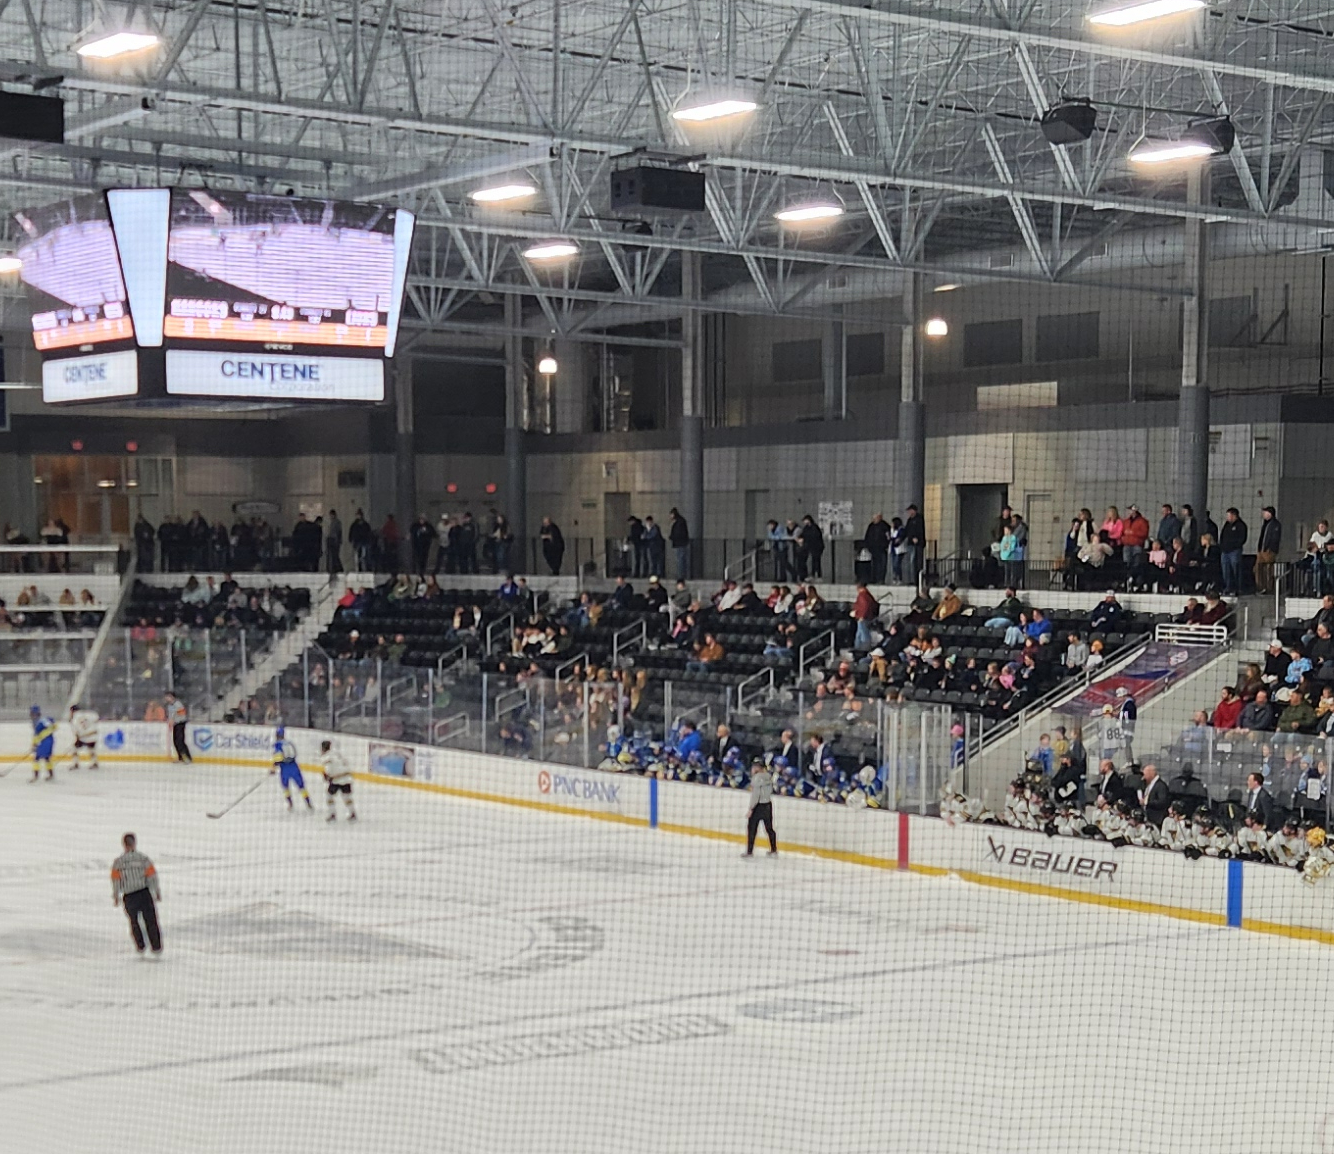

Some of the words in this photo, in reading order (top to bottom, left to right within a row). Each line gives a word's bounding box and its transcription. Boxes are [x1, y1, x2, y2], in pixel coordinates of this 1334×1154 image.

[221, 359, 320, 384] CENTENE
[1106, 728, 1121, 741] 88
[1009, 847, 1118, 882] BAUER
